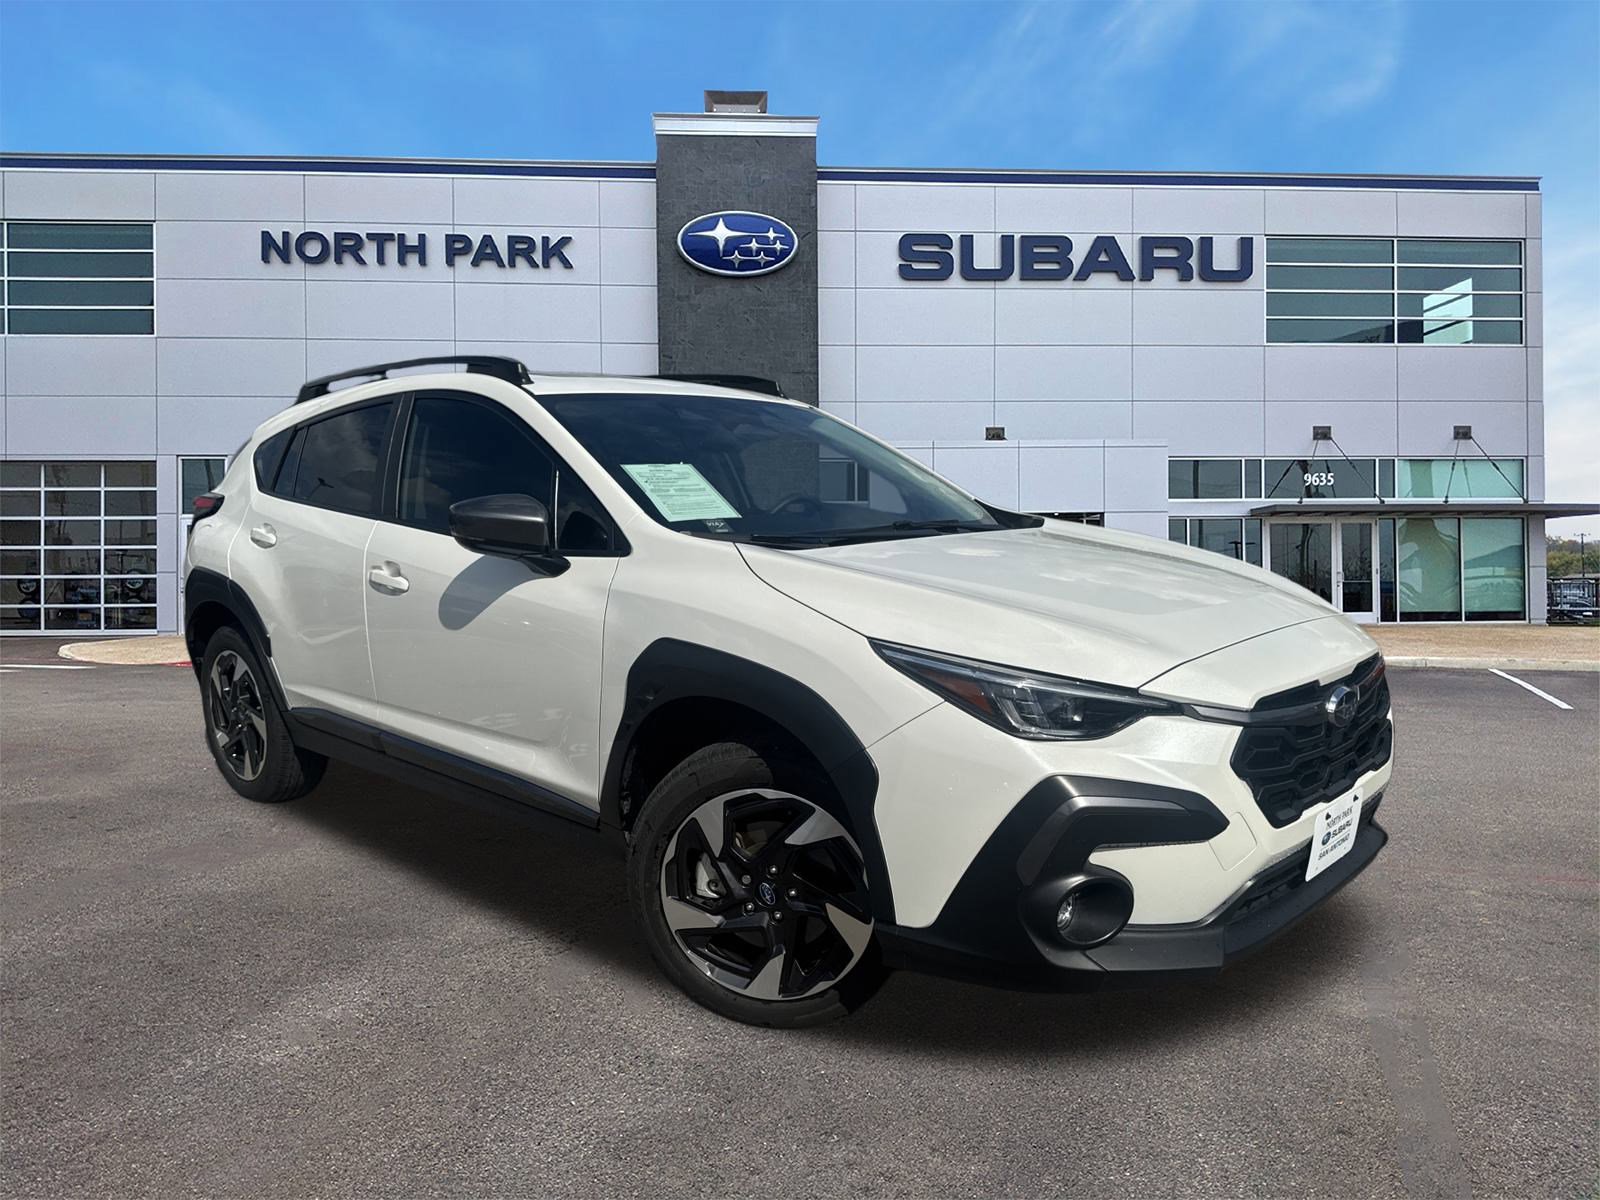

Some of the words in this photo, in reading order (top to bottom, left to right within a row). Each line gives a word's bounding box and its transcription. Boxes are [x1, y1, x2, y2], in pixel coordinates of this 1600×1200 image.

[261, 230, 427, 266] NORTH
[445, 233, 574, 269] PARK
[898, 232, 1254, 283] SUBARU
[1303, 472, 1334, 486] 9635
[1326, 814, 1342, 828] NORTH
[1342, 805, 1353, 818] PARK
[1331, 819, 1352, 838] SUBARU
[1318, 848, 1329, 861] SAN
[1330, 833, 1350, 850] ANTONIO
